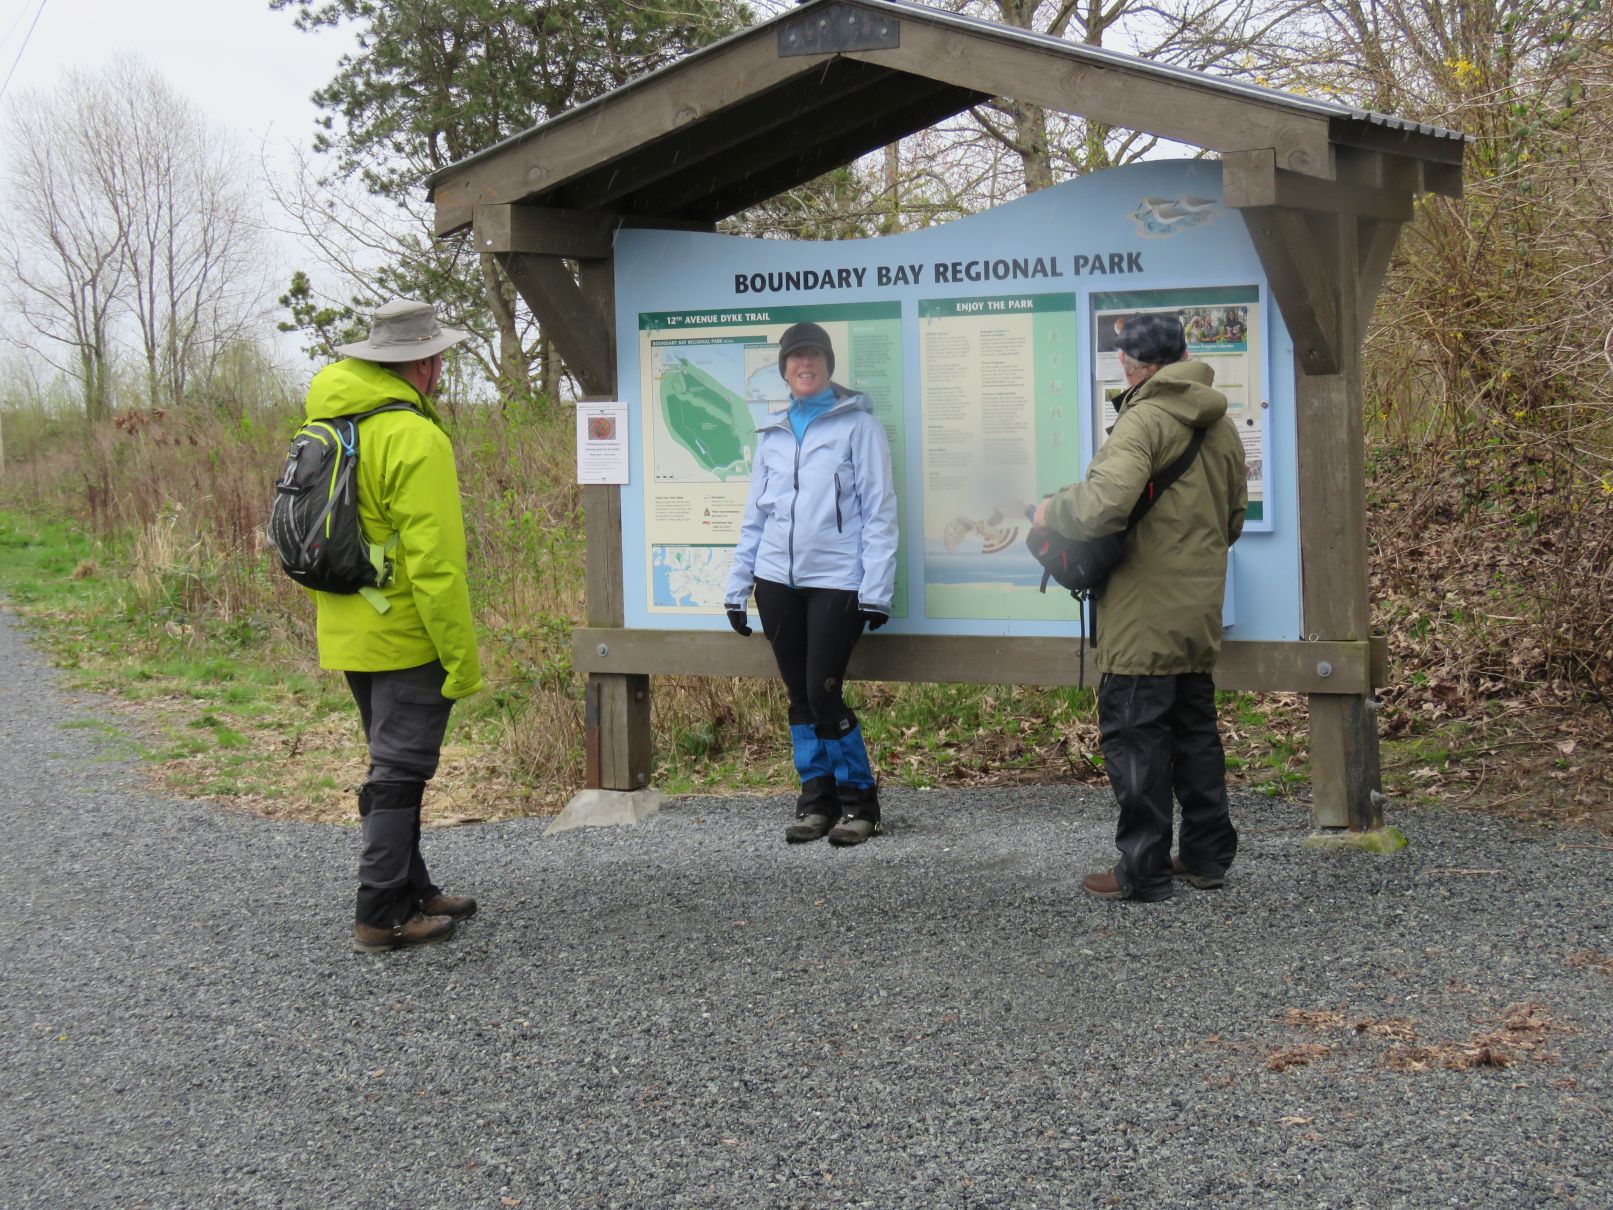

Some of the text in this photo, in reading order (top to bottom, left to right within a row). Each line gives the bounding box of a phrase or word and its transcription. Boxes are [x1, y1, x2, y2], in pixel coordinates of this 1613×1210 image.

[735, 252, 1144, 293] BOUNDARY BAY REGIONAL PARK
[956, 299, 1033, 312] ENJOY THE PARK
[685, 315, 718, 324] AVENUE
[720, 313, 742, 322] DYKE
[745, 312, 770, 321] TRAIL
